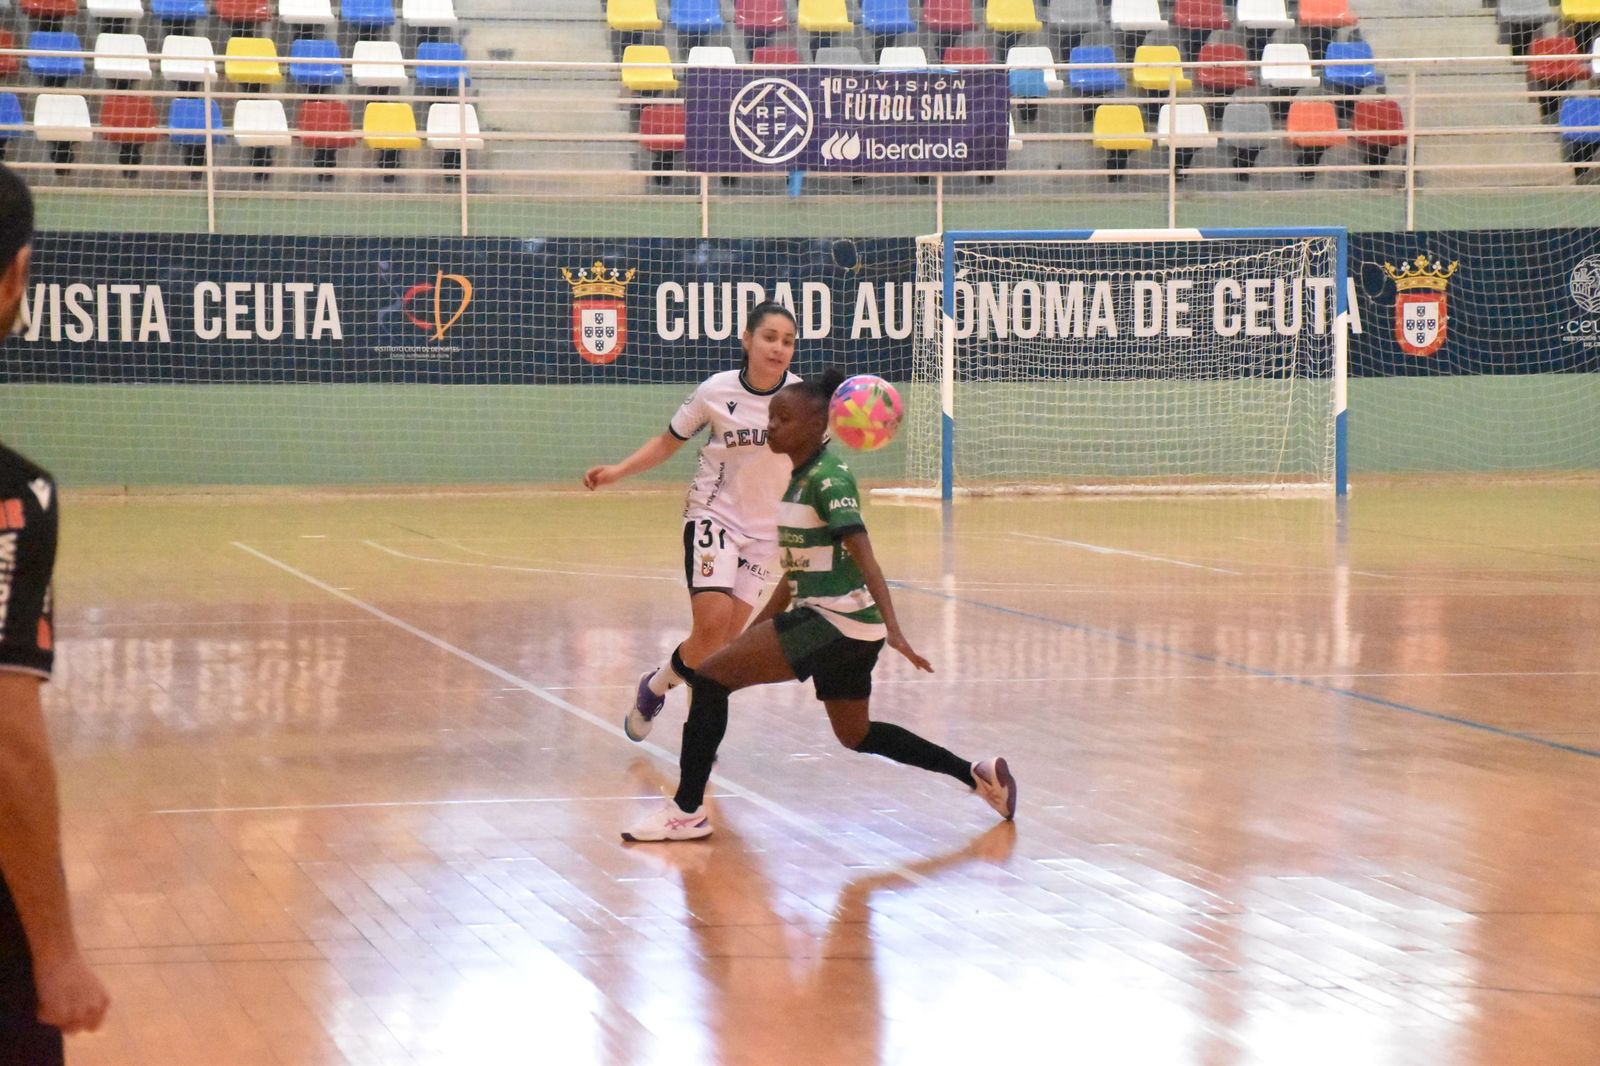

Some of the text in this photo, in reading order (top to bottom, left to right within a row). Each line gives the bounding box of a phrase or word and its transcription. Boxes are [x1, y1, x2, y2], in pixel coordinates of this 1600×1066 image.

[845, 77, 966, 91] DIVISIÓN
[845, 91, 967, 121] FÚTBOL SALA
[866, 137, 968, 160] Iberdrola
[20, 281, 343, 342] VISITA CEUTA
[656, 269, 1362, 340] CIUDAD AUTÓNOMA DE CEUTA
